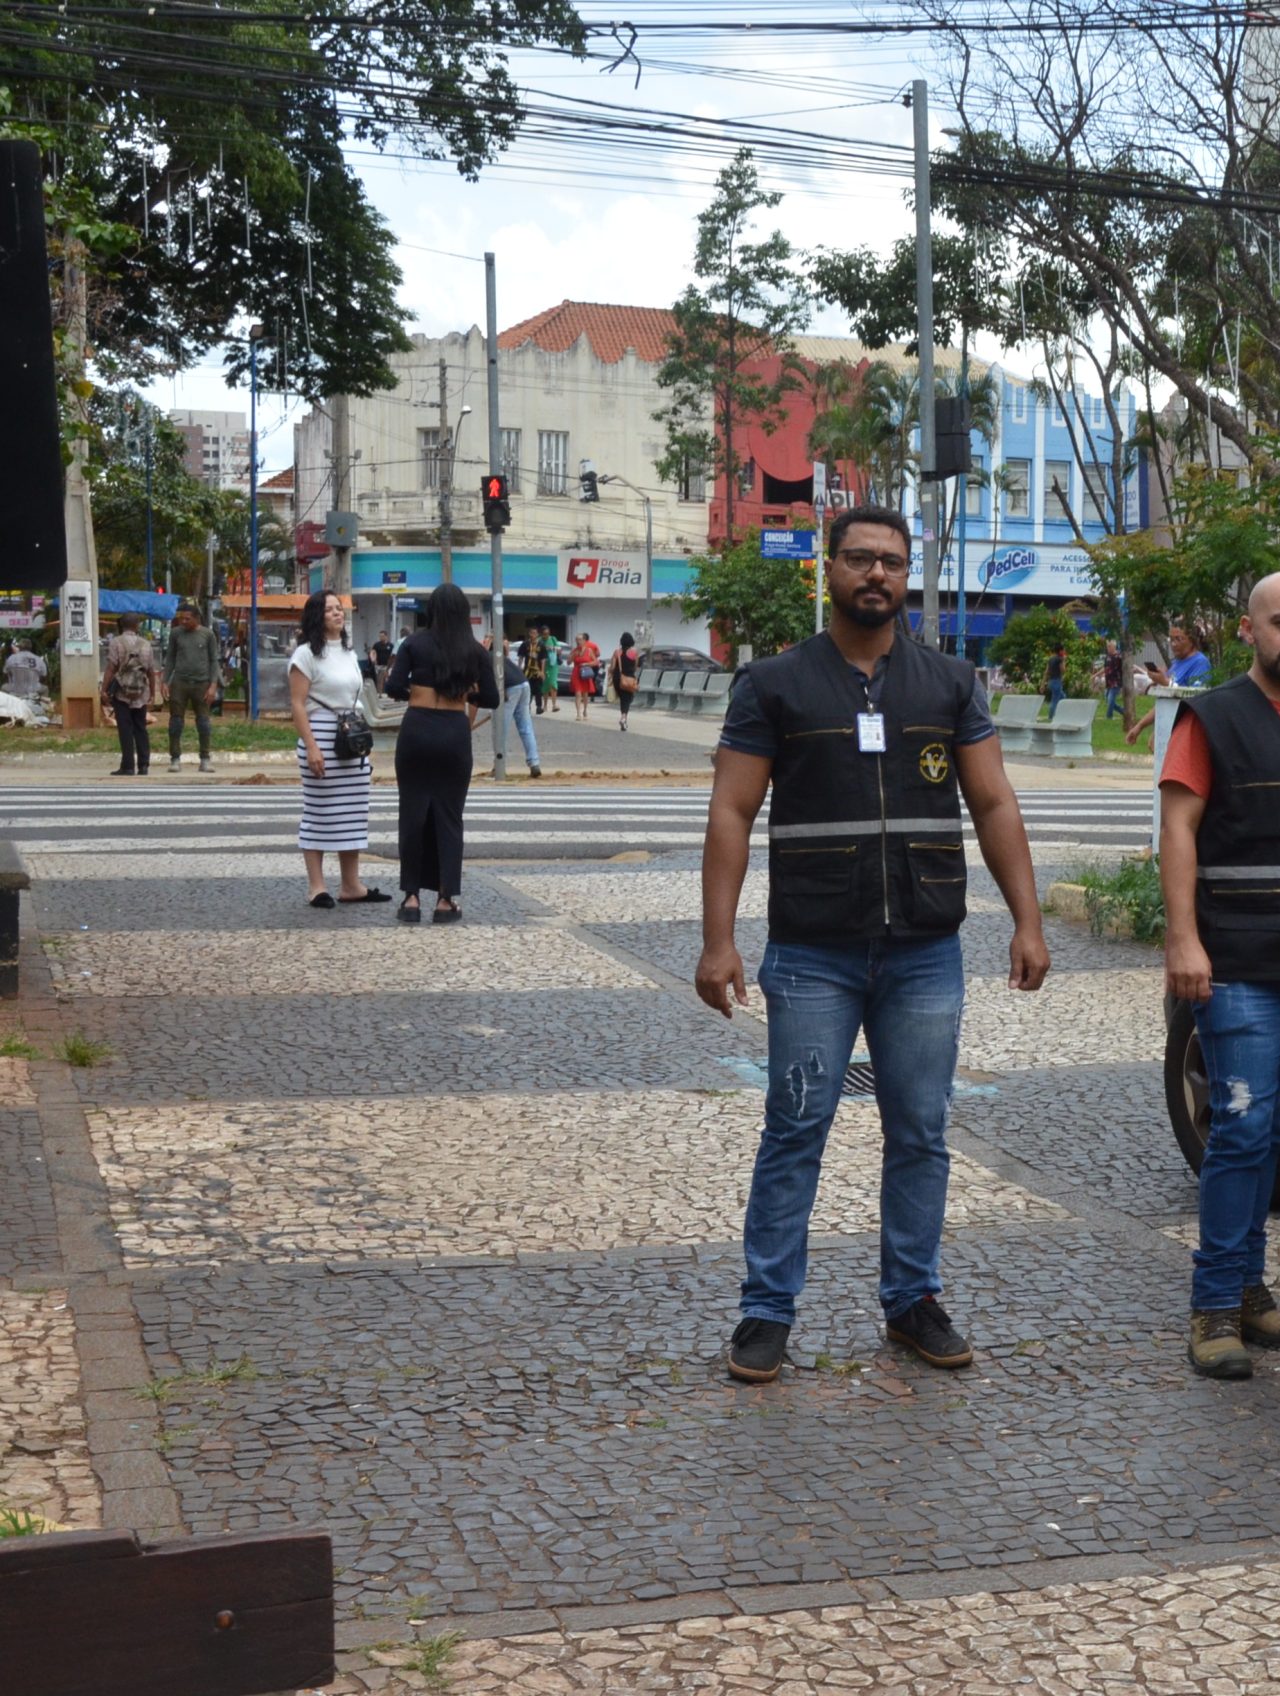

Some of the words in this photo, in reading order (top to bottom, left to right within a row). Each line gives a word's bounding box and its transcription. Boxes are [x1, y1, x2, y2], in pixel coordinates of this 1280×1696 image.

[601, 559, 630, 568] Droga
[1050, 565, 1072, 573] PARA
[598, 567, 643, 585] Raia
